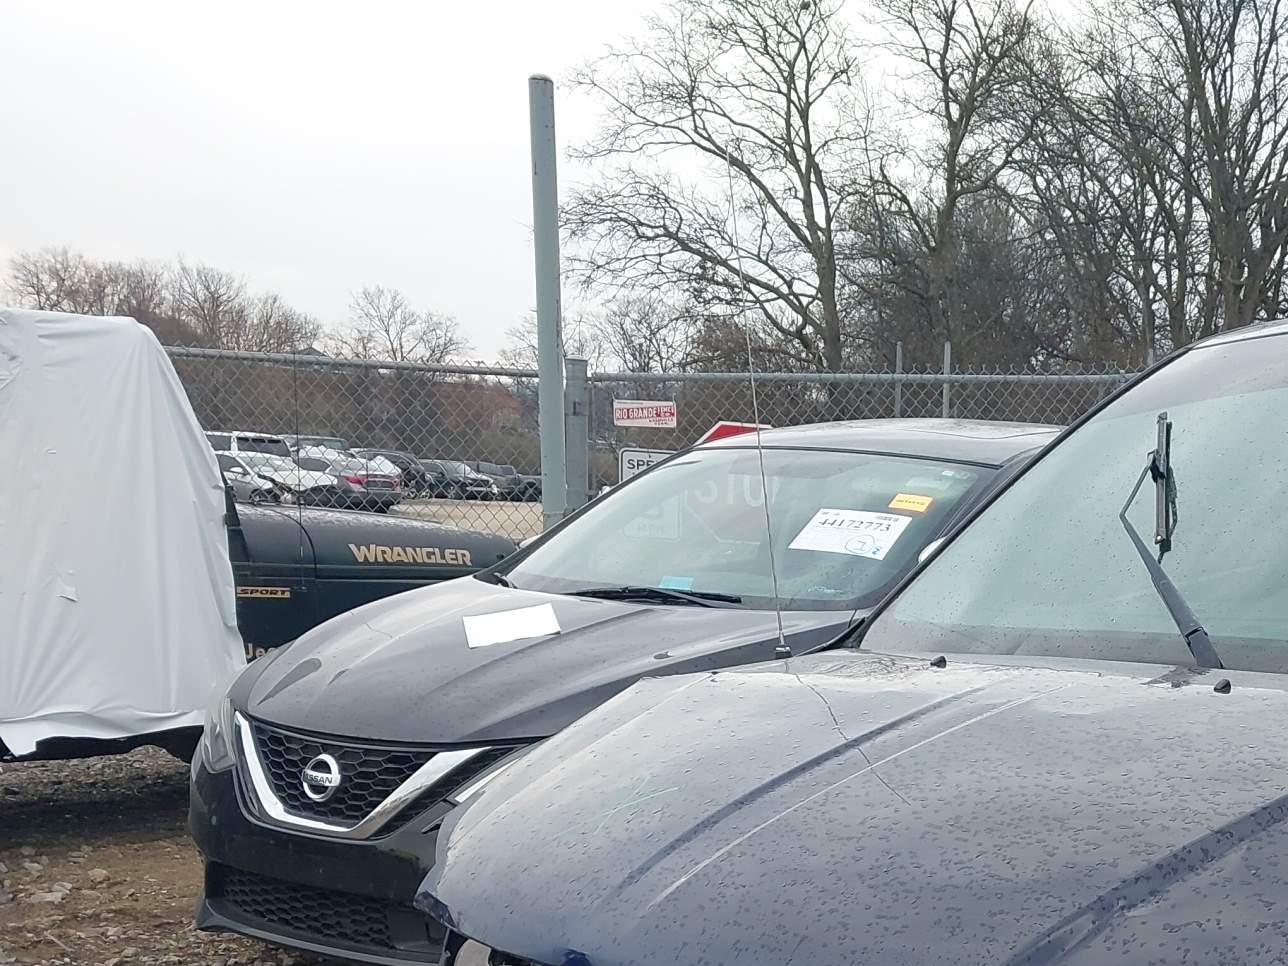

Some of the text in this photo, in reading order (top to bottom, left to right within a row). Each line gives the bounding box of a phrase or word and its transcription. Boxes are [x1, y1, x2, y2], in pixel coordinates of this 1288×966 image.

[615, 408, 627, 419] RIO
[629, 406, 656, 418] GRANDE
[627, 459, 659, 470] SPE
[347, 543, 472, 566] WRANGLER
[239, 588, 289, 597] SPORT
